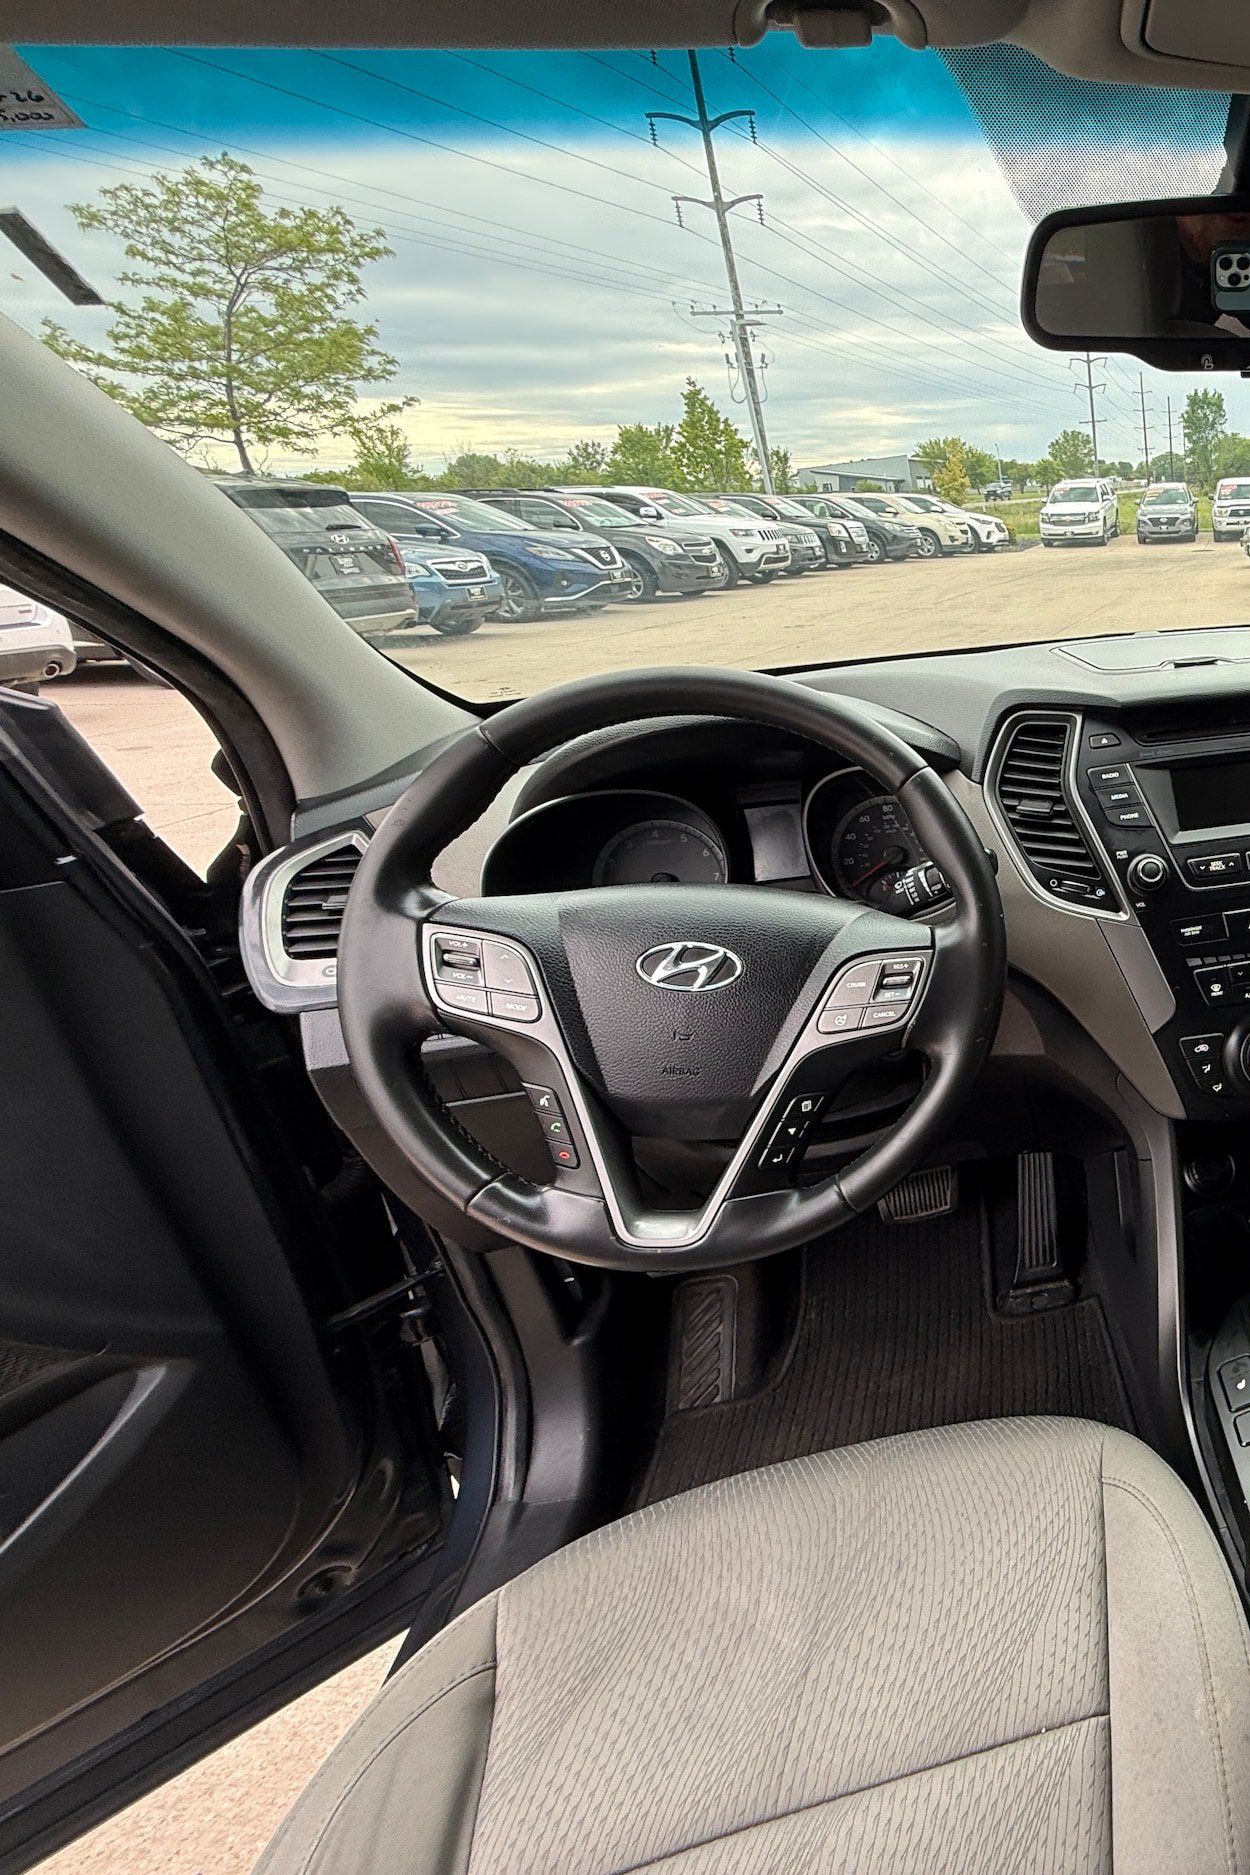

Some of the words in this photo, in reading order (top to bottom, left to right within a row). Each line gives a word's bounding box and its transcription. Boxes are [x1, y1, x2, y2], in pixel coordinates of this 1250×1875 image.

[1101, 772, 1120, 780] RADIO
[1110, 792, 1129, 801] MEDIA
[882, 804, 894, 813] 80
[859, 815, 871, 823] 60
[1120, 812, 1139, 820] PHONE
[680, 834, 688, 843] 5
[845, 832, 857, 841] 40
[702, 849, 710, 857] 6
[456, 993, 477, 1003] MUTE
[505, 1002, 529, 1012] MODE
[873, 1011, 897, 1019] CANCEL
[661, 1066, 701, 1076] AIRBAG
